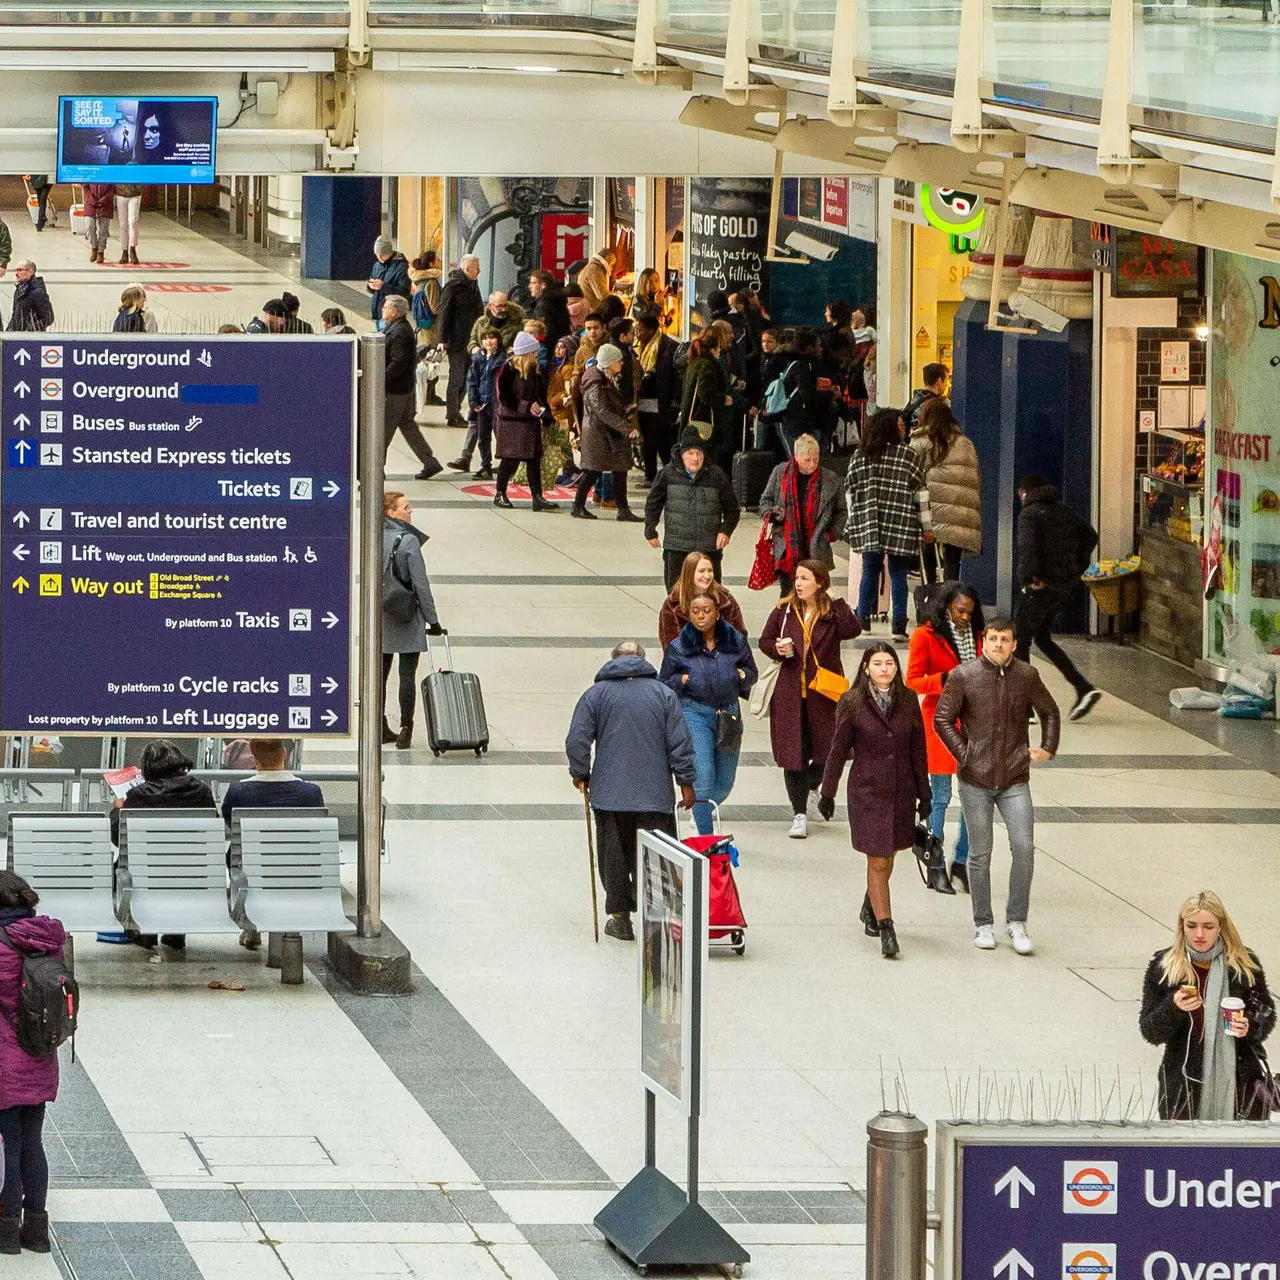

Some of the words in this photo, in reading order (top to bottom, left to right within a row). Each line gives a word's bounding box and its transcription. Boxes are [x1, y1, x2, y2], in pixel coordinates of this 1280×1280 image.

[93, 101, 103, 109] IT.
[74, 116, 114, 125] SORTED.
[704, 216, 716, 237] OF
[720, 215, 758, 238] GOLD
[1121, 260, 1193, 281] CASA
[73, 349, 190, 369] Underground
[73, 382, 178, 401] Overground
[73, 414, 124, 430] Buses
[129, 422, 146, 430] Bus
[148, 422, 179, 430] station
[73, 447, 151, 463] Stansted
[158, 448, 226, 467] Express
[231, 448, 290, 464] tickets
[218, 480, 280, 496] Tickets
[71, 512, 121, 528] Travel
[127, 512, 159, 528] and
[165, 513, 224, 529] tourist
[230, 515, 286, 529] centre
[72, 545, 101, 561] Lift
[106, 552, 125, 563] Way
[127, 554, 144, 562] out,
[147, 553, 206, 563] Underground
[208, 553, 225, 562] and
[227, 553, 243, 562] Bus
[246, 554, 277, 562] station
[71, 578, 108, 597] Way
[114, 580, 143, 594] out
[166, 618, 177, 629] By
[179, 618, 218, 628] platform
[220, 619, 232, 627] 10
[236, 612, 279, 628] Taxis
[108, 683, 120, 693] By
[122, 683, 160, 693] platform
[163, 684, 174, 692] 10
[180, 676, 228, 696] Cycle
[234, 677, 278, 693] racks
[29, 715, 48, 723] Lost
[51, 716, 90, 726] property
[92, 715, 103, 726] by
[105, 716, 144, 726] platform
[146, 716, 158, 724] 10
[163, 709, 198, 725] Left
[204, 709, 279, 729] Luggage
